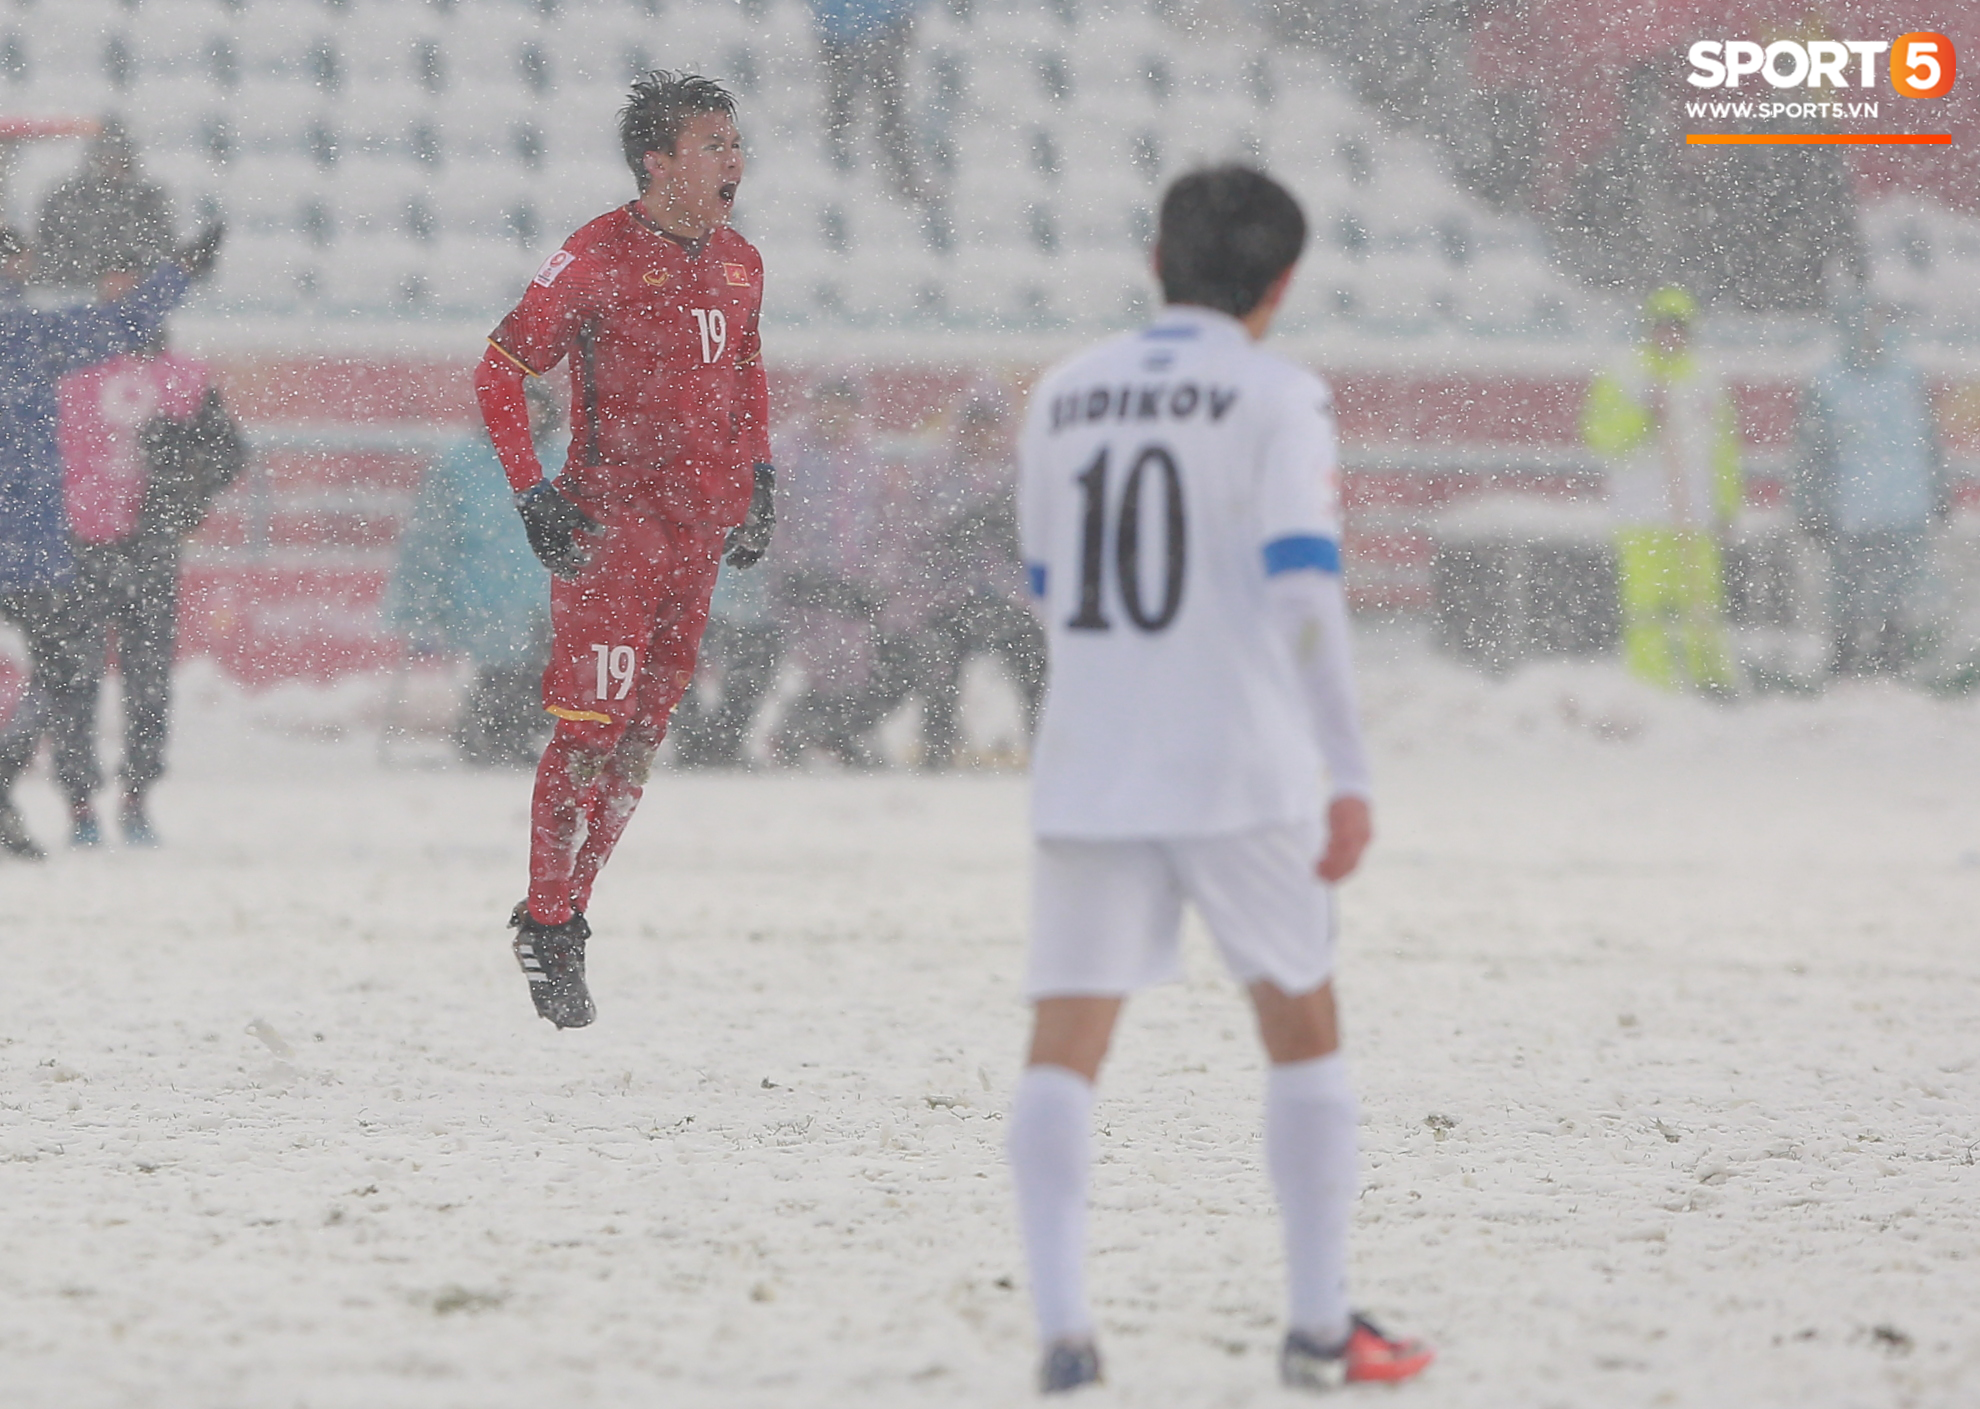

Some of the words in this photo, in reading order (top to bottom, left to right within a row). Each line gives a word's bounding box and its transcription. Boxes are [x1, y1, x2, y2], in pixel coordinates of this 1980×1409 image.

[690, 308, 727, 363] 19
[1066, 443, 1187, 634] 10
[591, 643, 636, 700] 19
